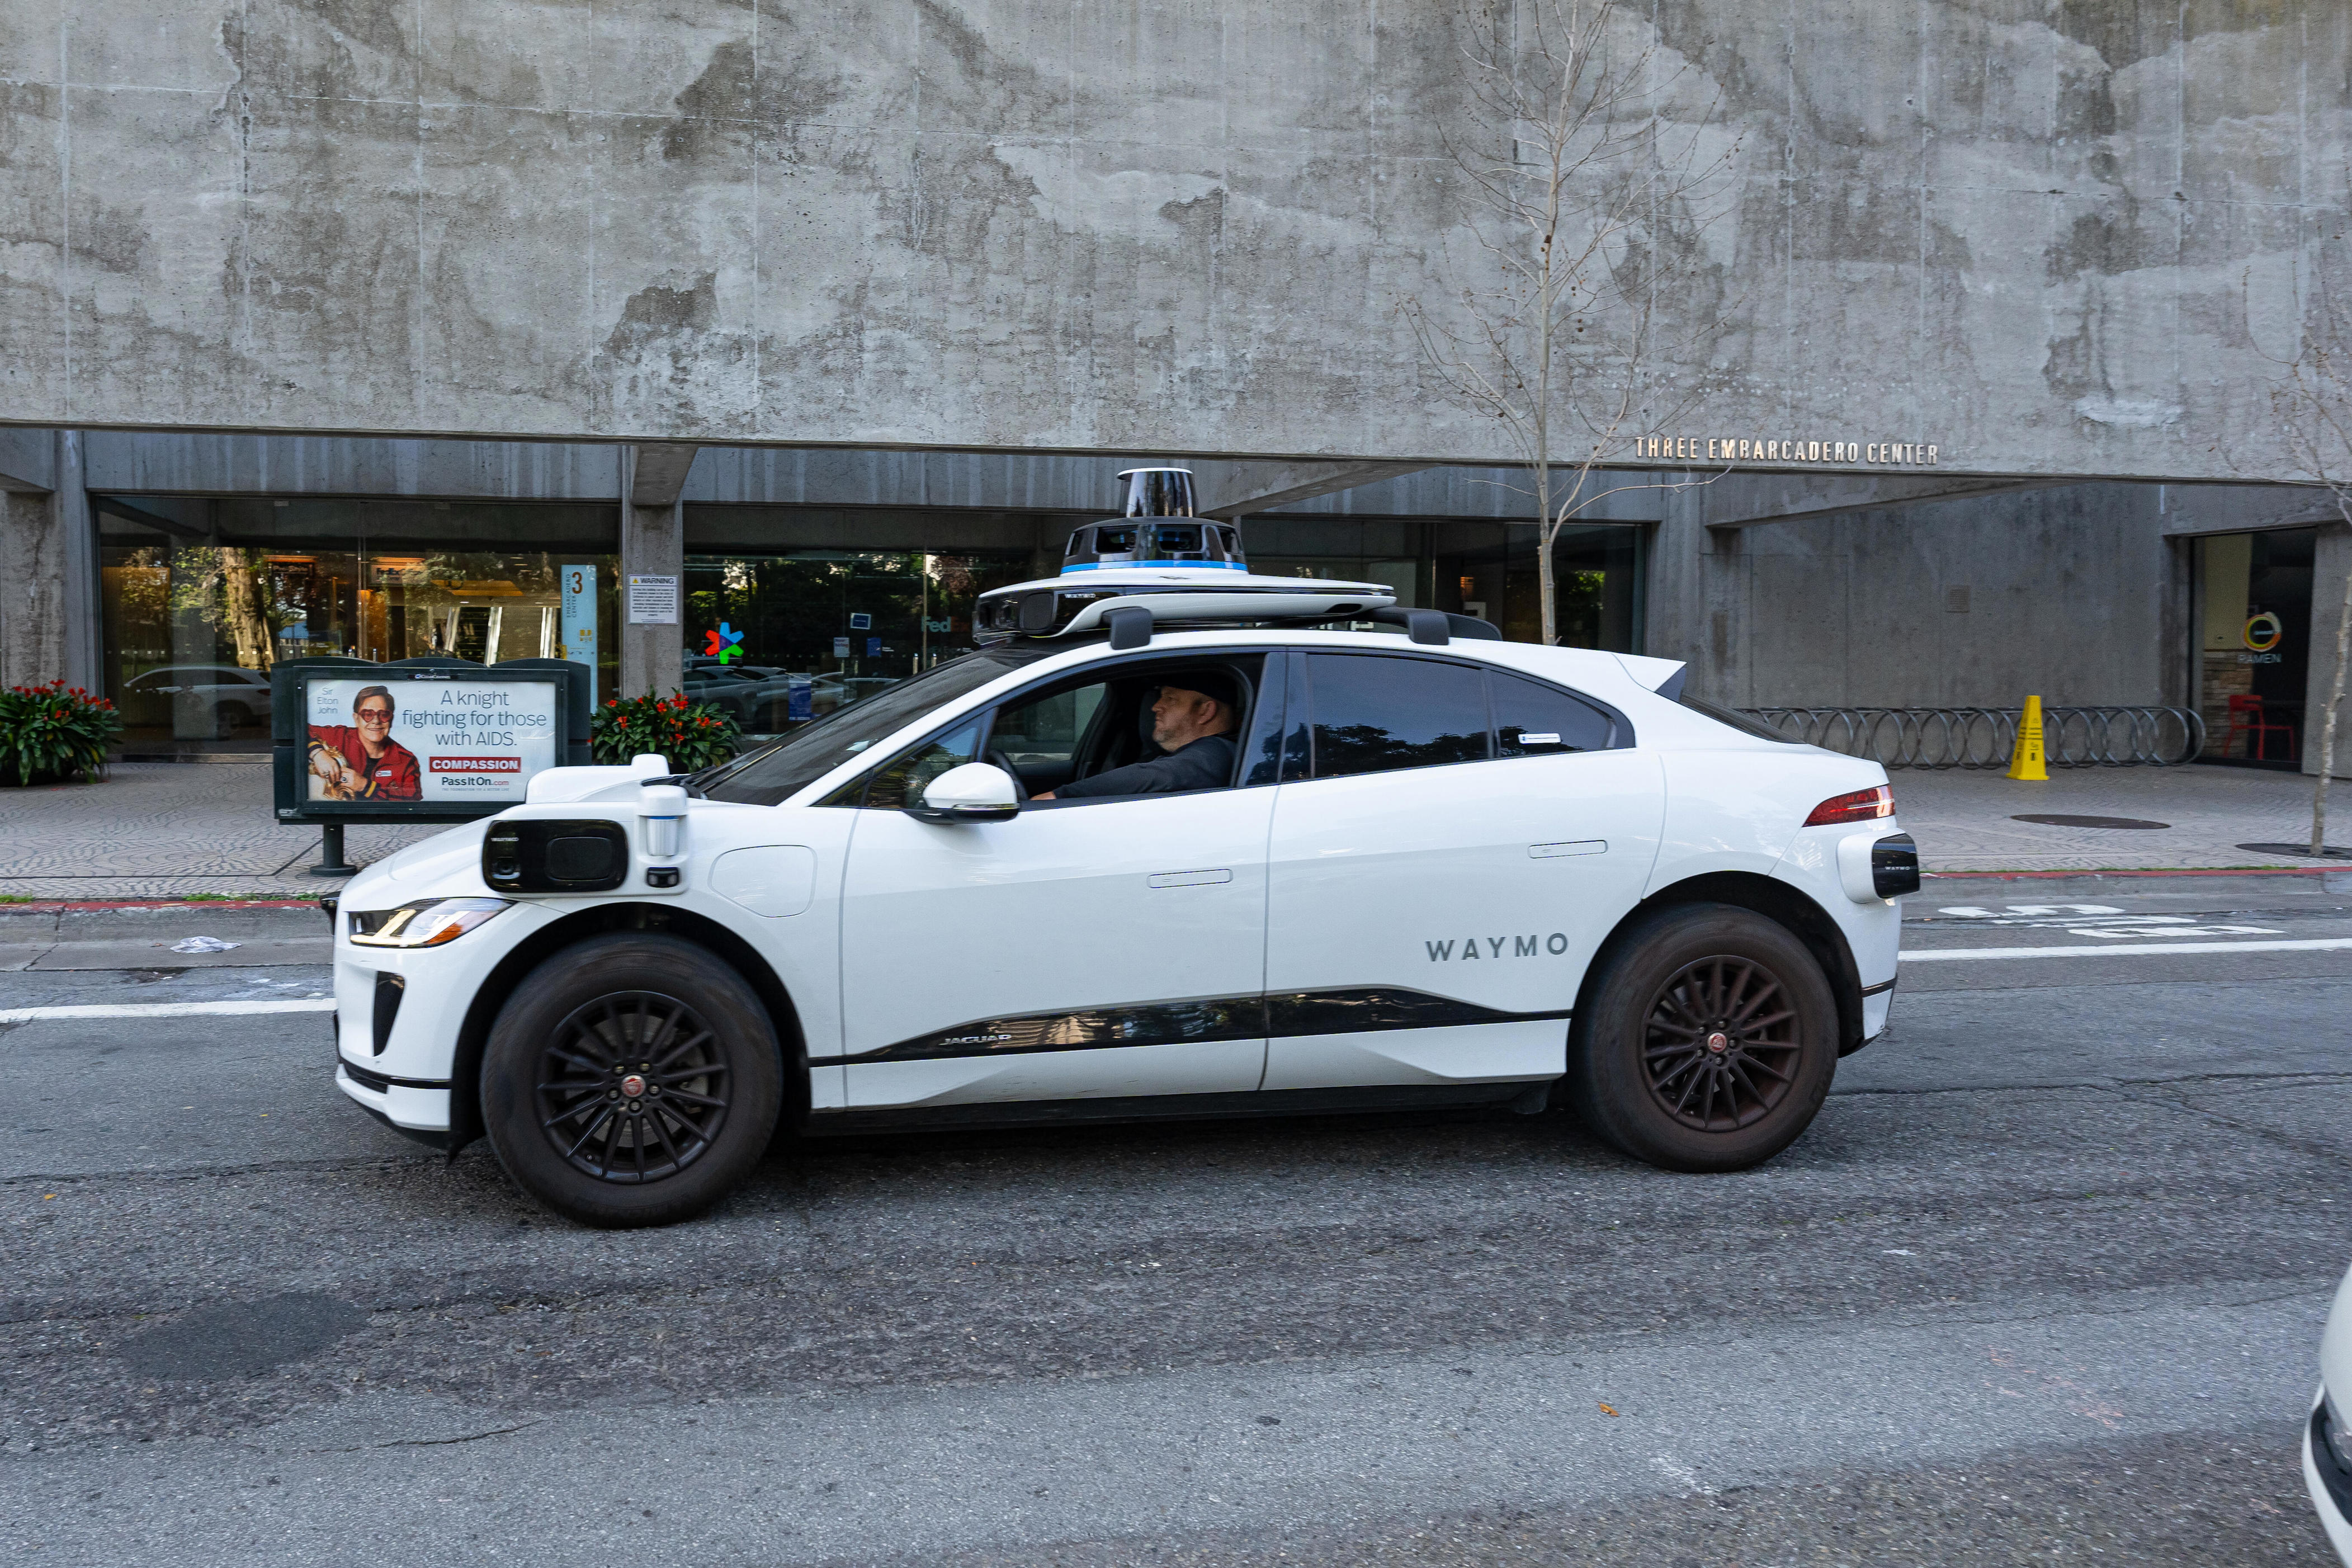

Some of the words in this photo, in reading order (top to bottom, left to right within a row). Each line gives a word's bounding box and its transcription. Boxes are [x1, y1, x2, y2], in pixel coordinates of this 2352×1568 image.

[1635, 436, 1698, 458] THREE
[1708, 438, 1859, 462] EMBARCADERO
[1867, 443, 1939, 465] CENTER
[572, 572, 583, 594] 3
[440, 690, 453, 705] A
[457, 690, 510, 709] knight
[402, 710, 467, 729] fighting
[470, 710, 494, 726] for
[497, 711, 547, 726] those
[434, 730, 471, 745] with
[475, 731, 518, 746] AIDS.
[432, 759, 519, 770] COMPASSION
[1425, 932, 1568, 962] WAYMO
